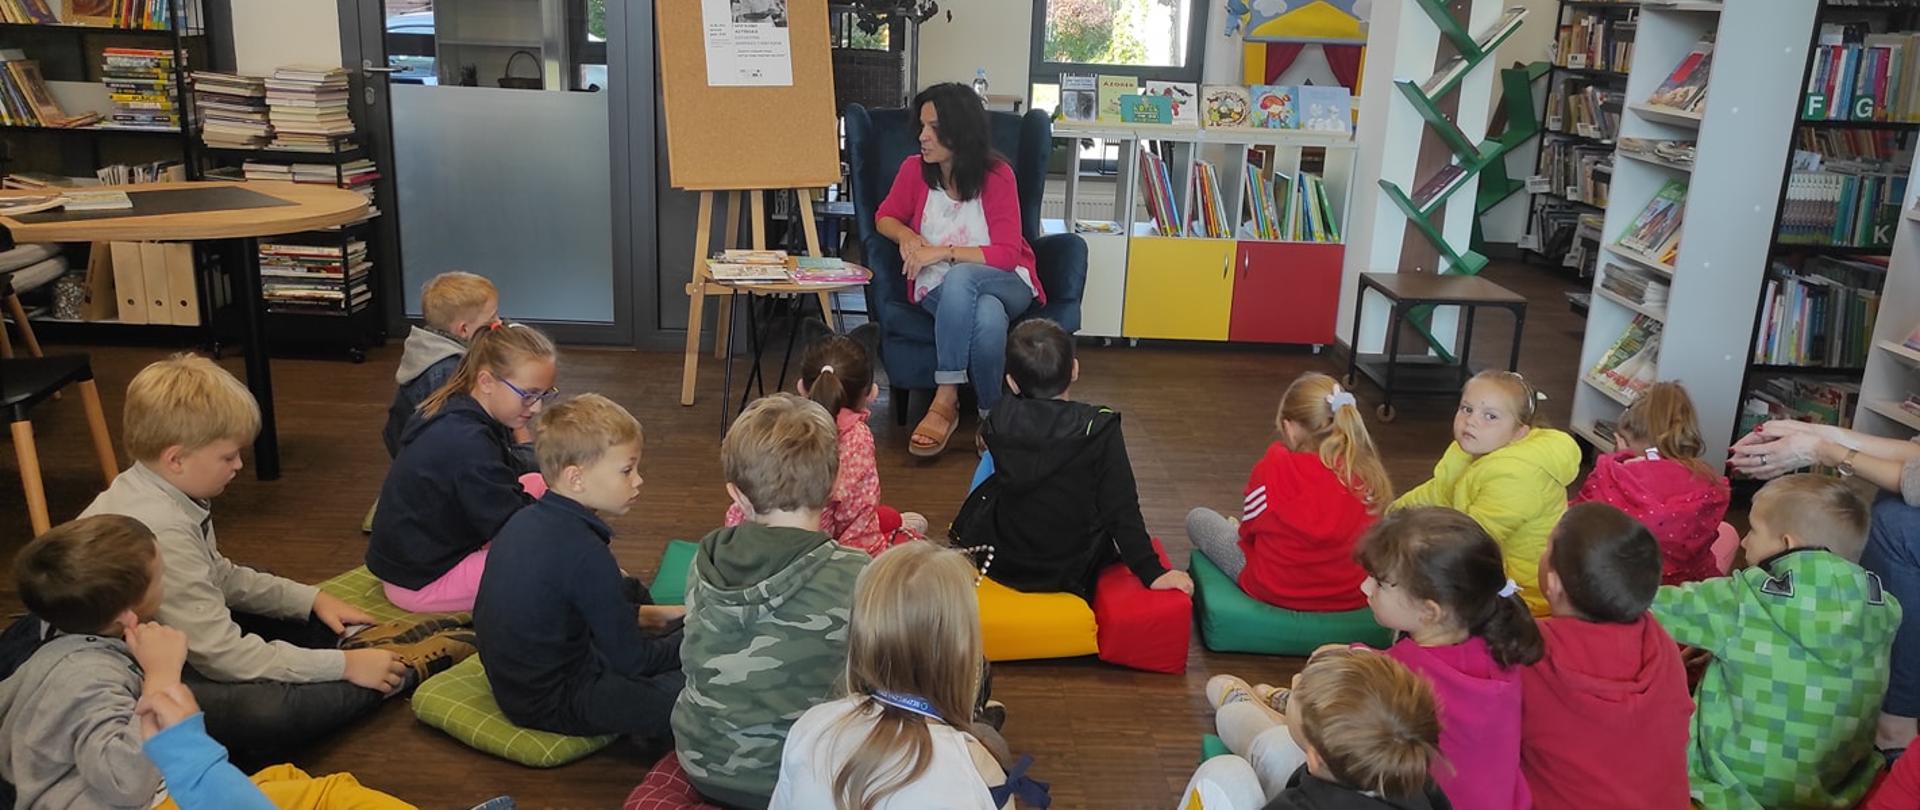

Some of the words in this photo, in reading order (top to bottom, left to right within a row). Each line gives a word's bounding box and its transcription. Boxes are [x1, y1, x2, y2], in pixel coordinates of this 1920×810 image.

[1808, 95, 1824, 116] F
[1855, 97, 1874, 118] G
[1873, 225, 1890, 244] K
